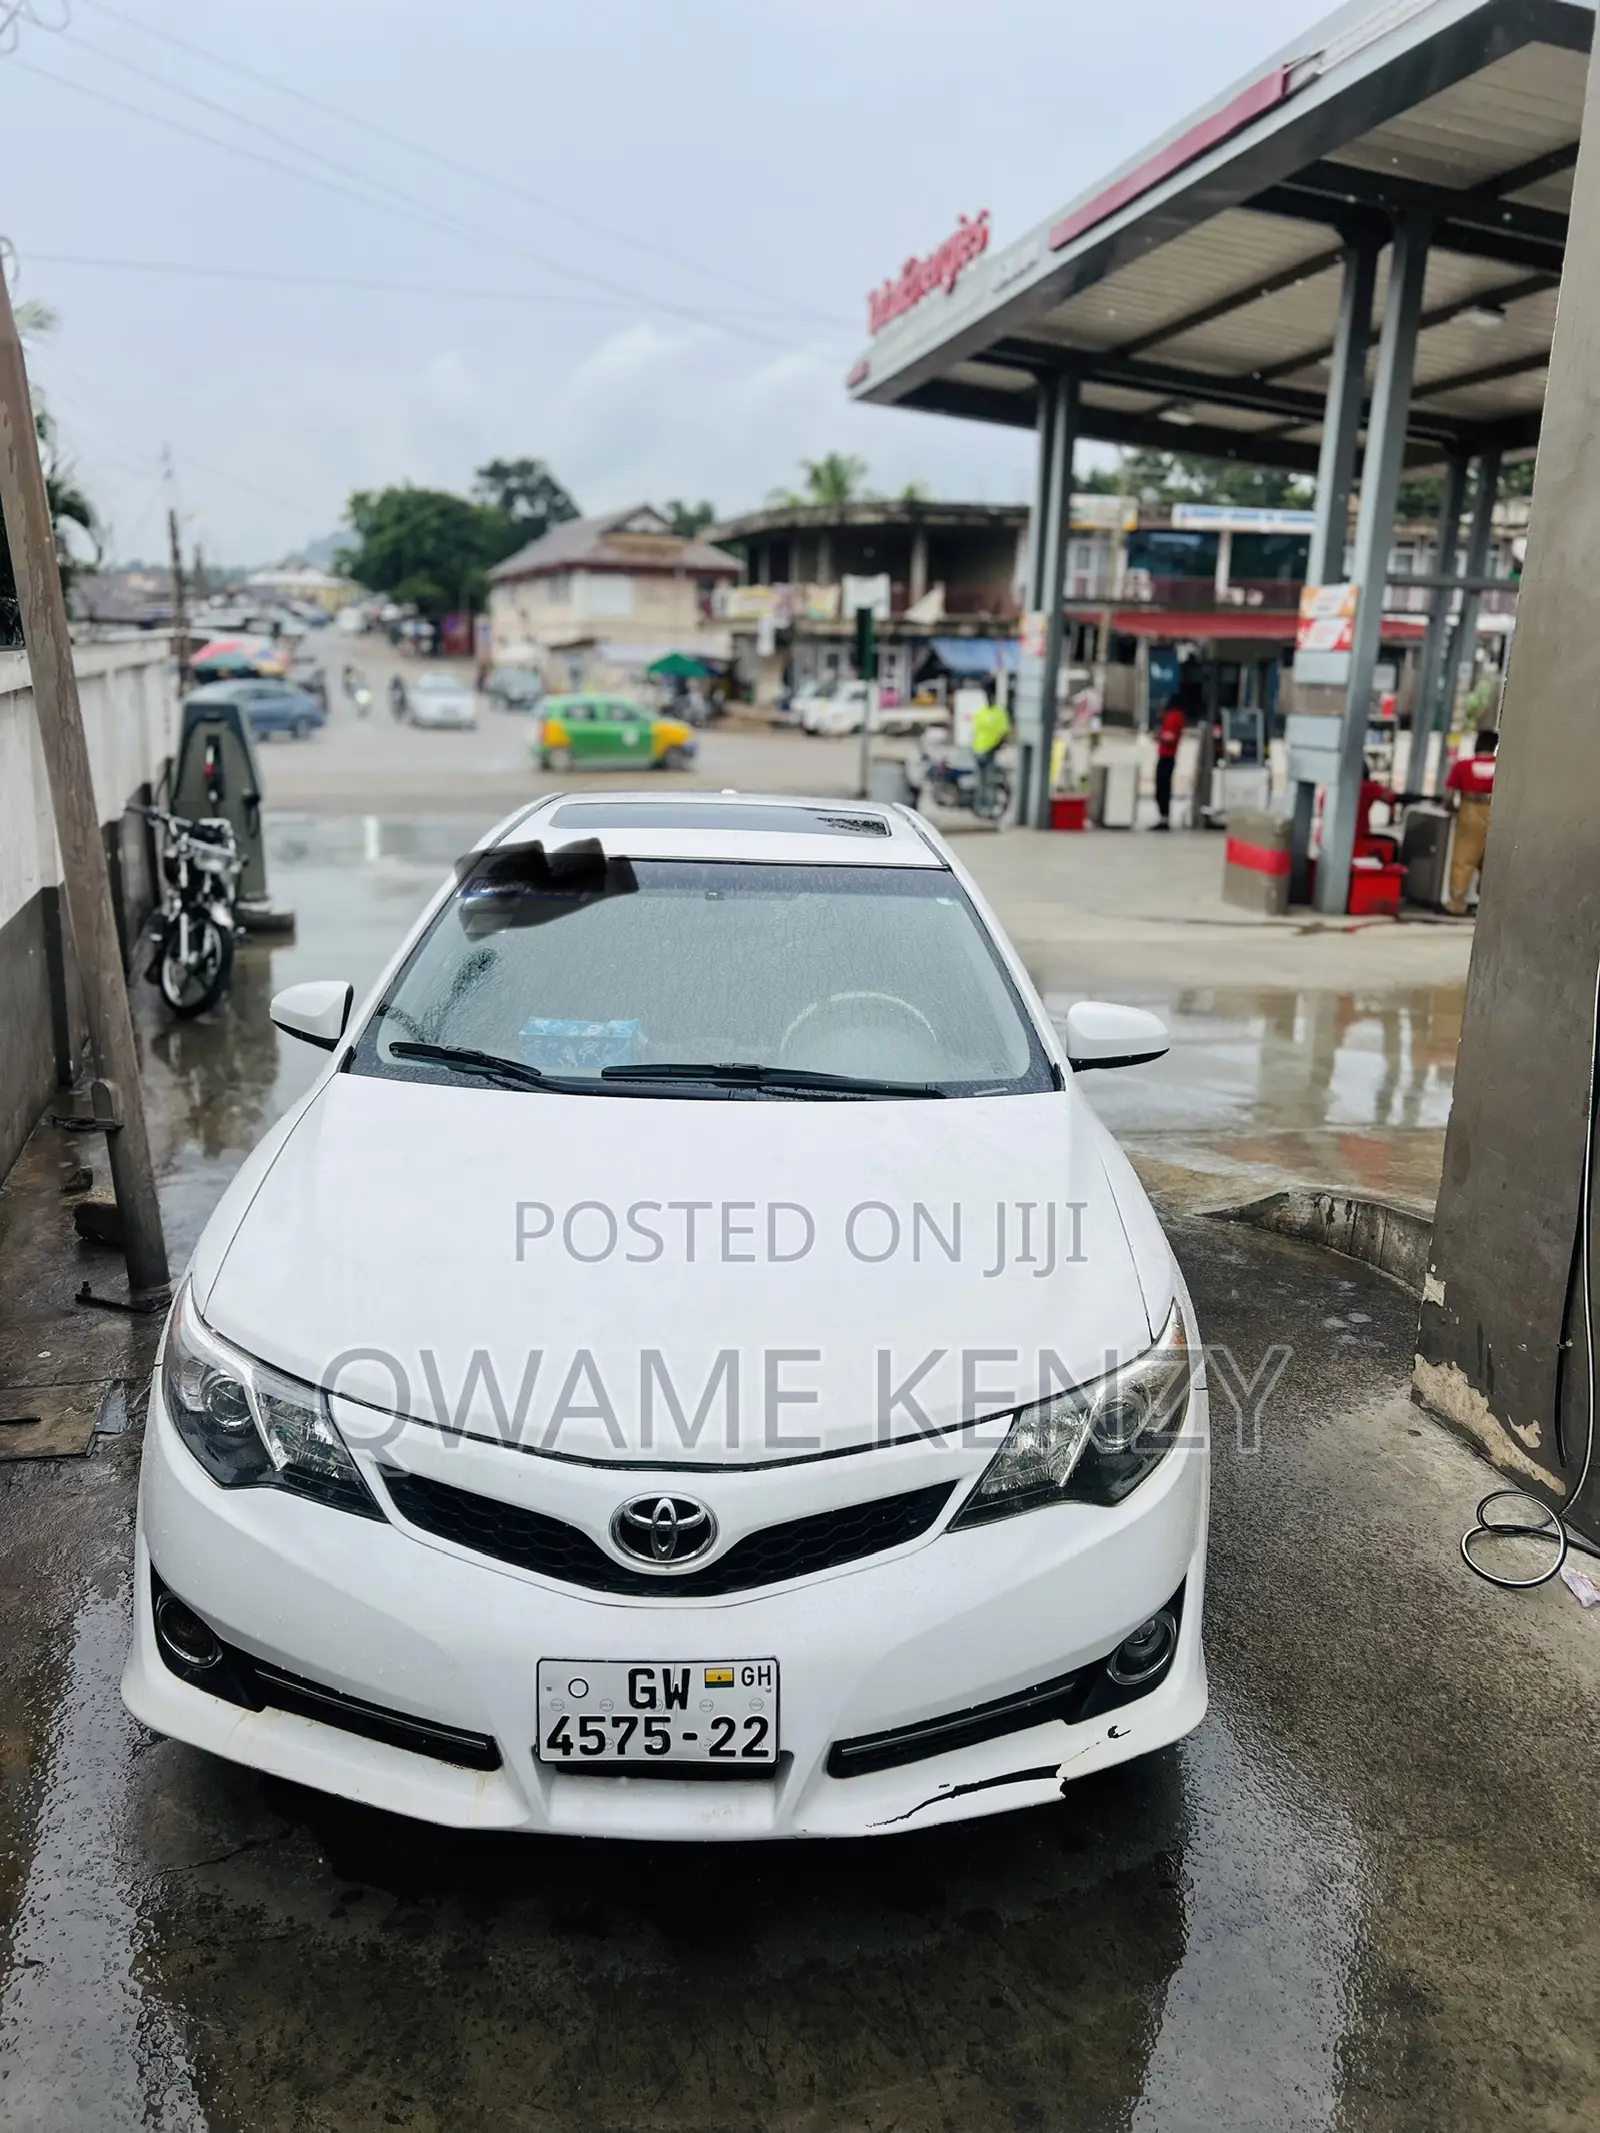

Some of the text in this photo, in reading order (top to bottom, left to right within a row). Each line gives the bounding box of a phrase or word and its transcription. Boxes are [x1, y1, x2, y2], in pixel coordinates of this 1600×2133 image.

[628, 1665, 771, 1710] GW GH
[546, 1715, 769, 1757] 4575-22
